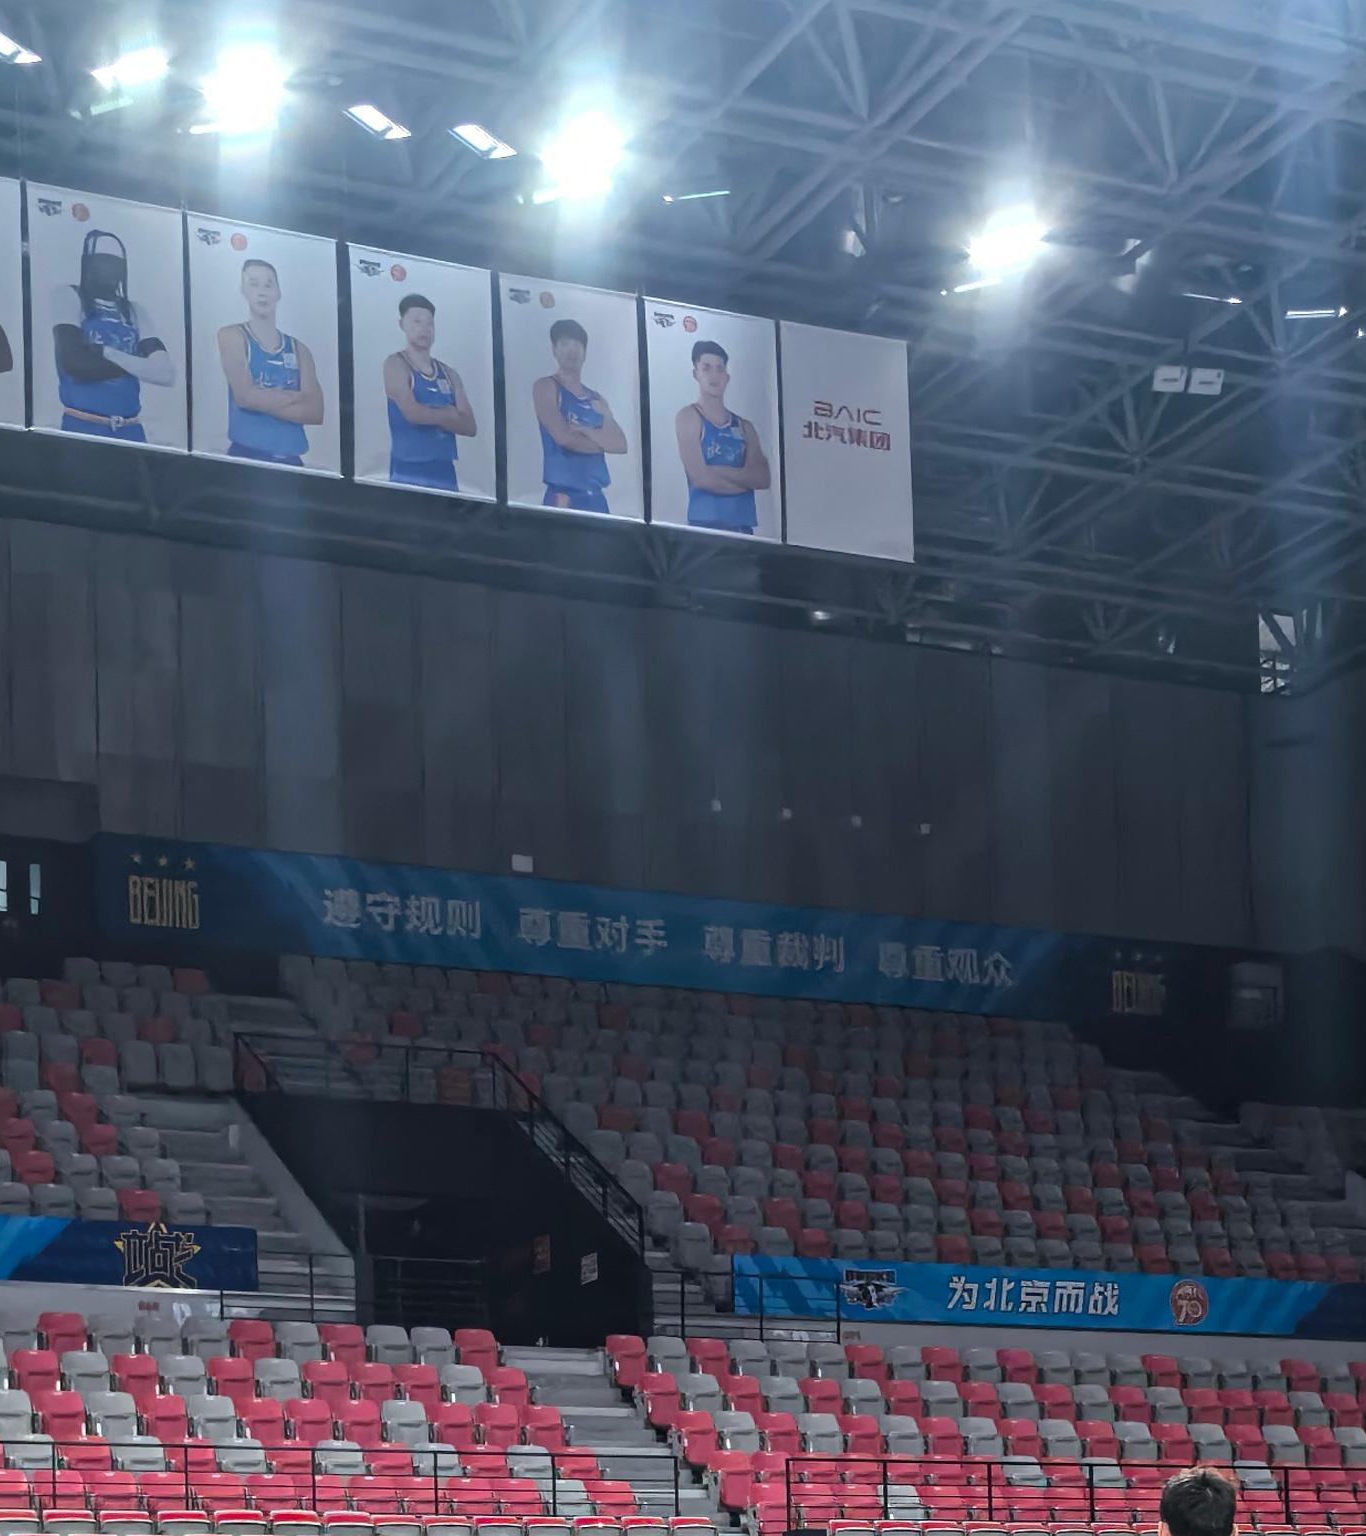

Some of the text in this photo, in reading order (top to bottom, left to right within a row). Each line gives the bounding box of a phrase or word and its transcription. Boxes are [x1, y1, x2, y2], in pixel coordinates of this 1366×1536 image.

[813, 400, 882, 426] BAIC
[803, 420, 891, 451] 北汽集团
[128, 875, 201, 930] BEIJING
[324, 888, 481, 940] 遵守规则
[947, 1275, 1119, 1316] 为北京而战
